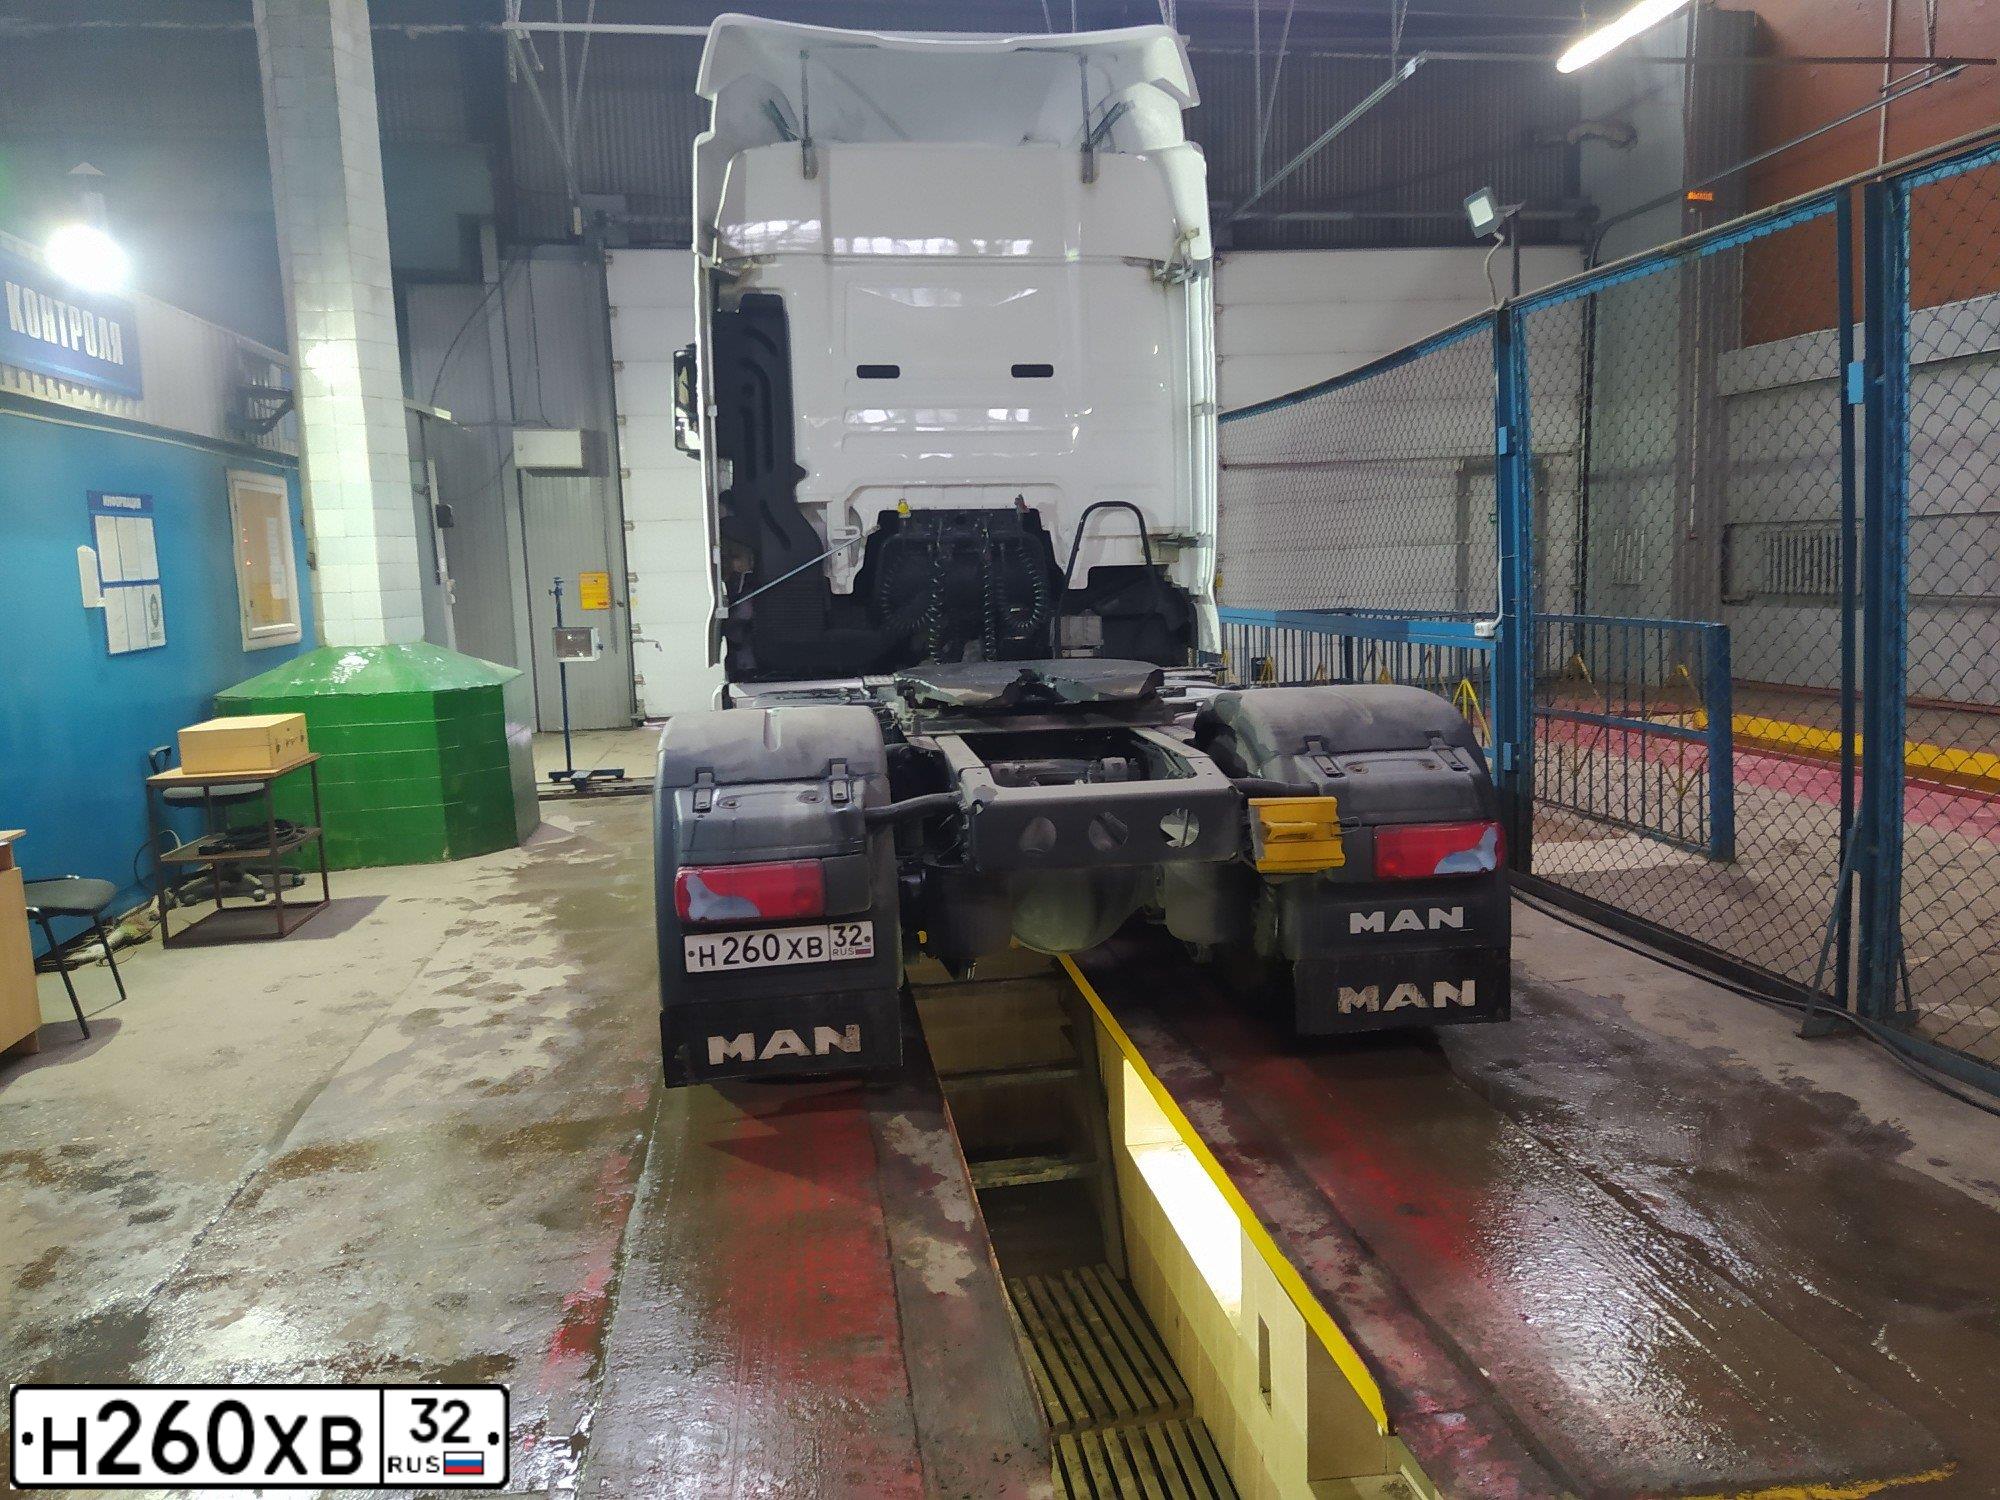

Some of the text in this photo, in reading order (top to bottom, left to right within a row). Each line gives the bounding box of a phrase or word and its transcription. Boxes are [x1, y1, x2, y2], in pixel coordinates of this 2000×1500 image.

[1349, 906, 1464, 935] MAN
[832, 924, 863, 948] 32
[832, 948, 855, 957] RUS
[1337, 979, 1476, 1014] MAN
[706, 1023, 862, 1066] MAN
